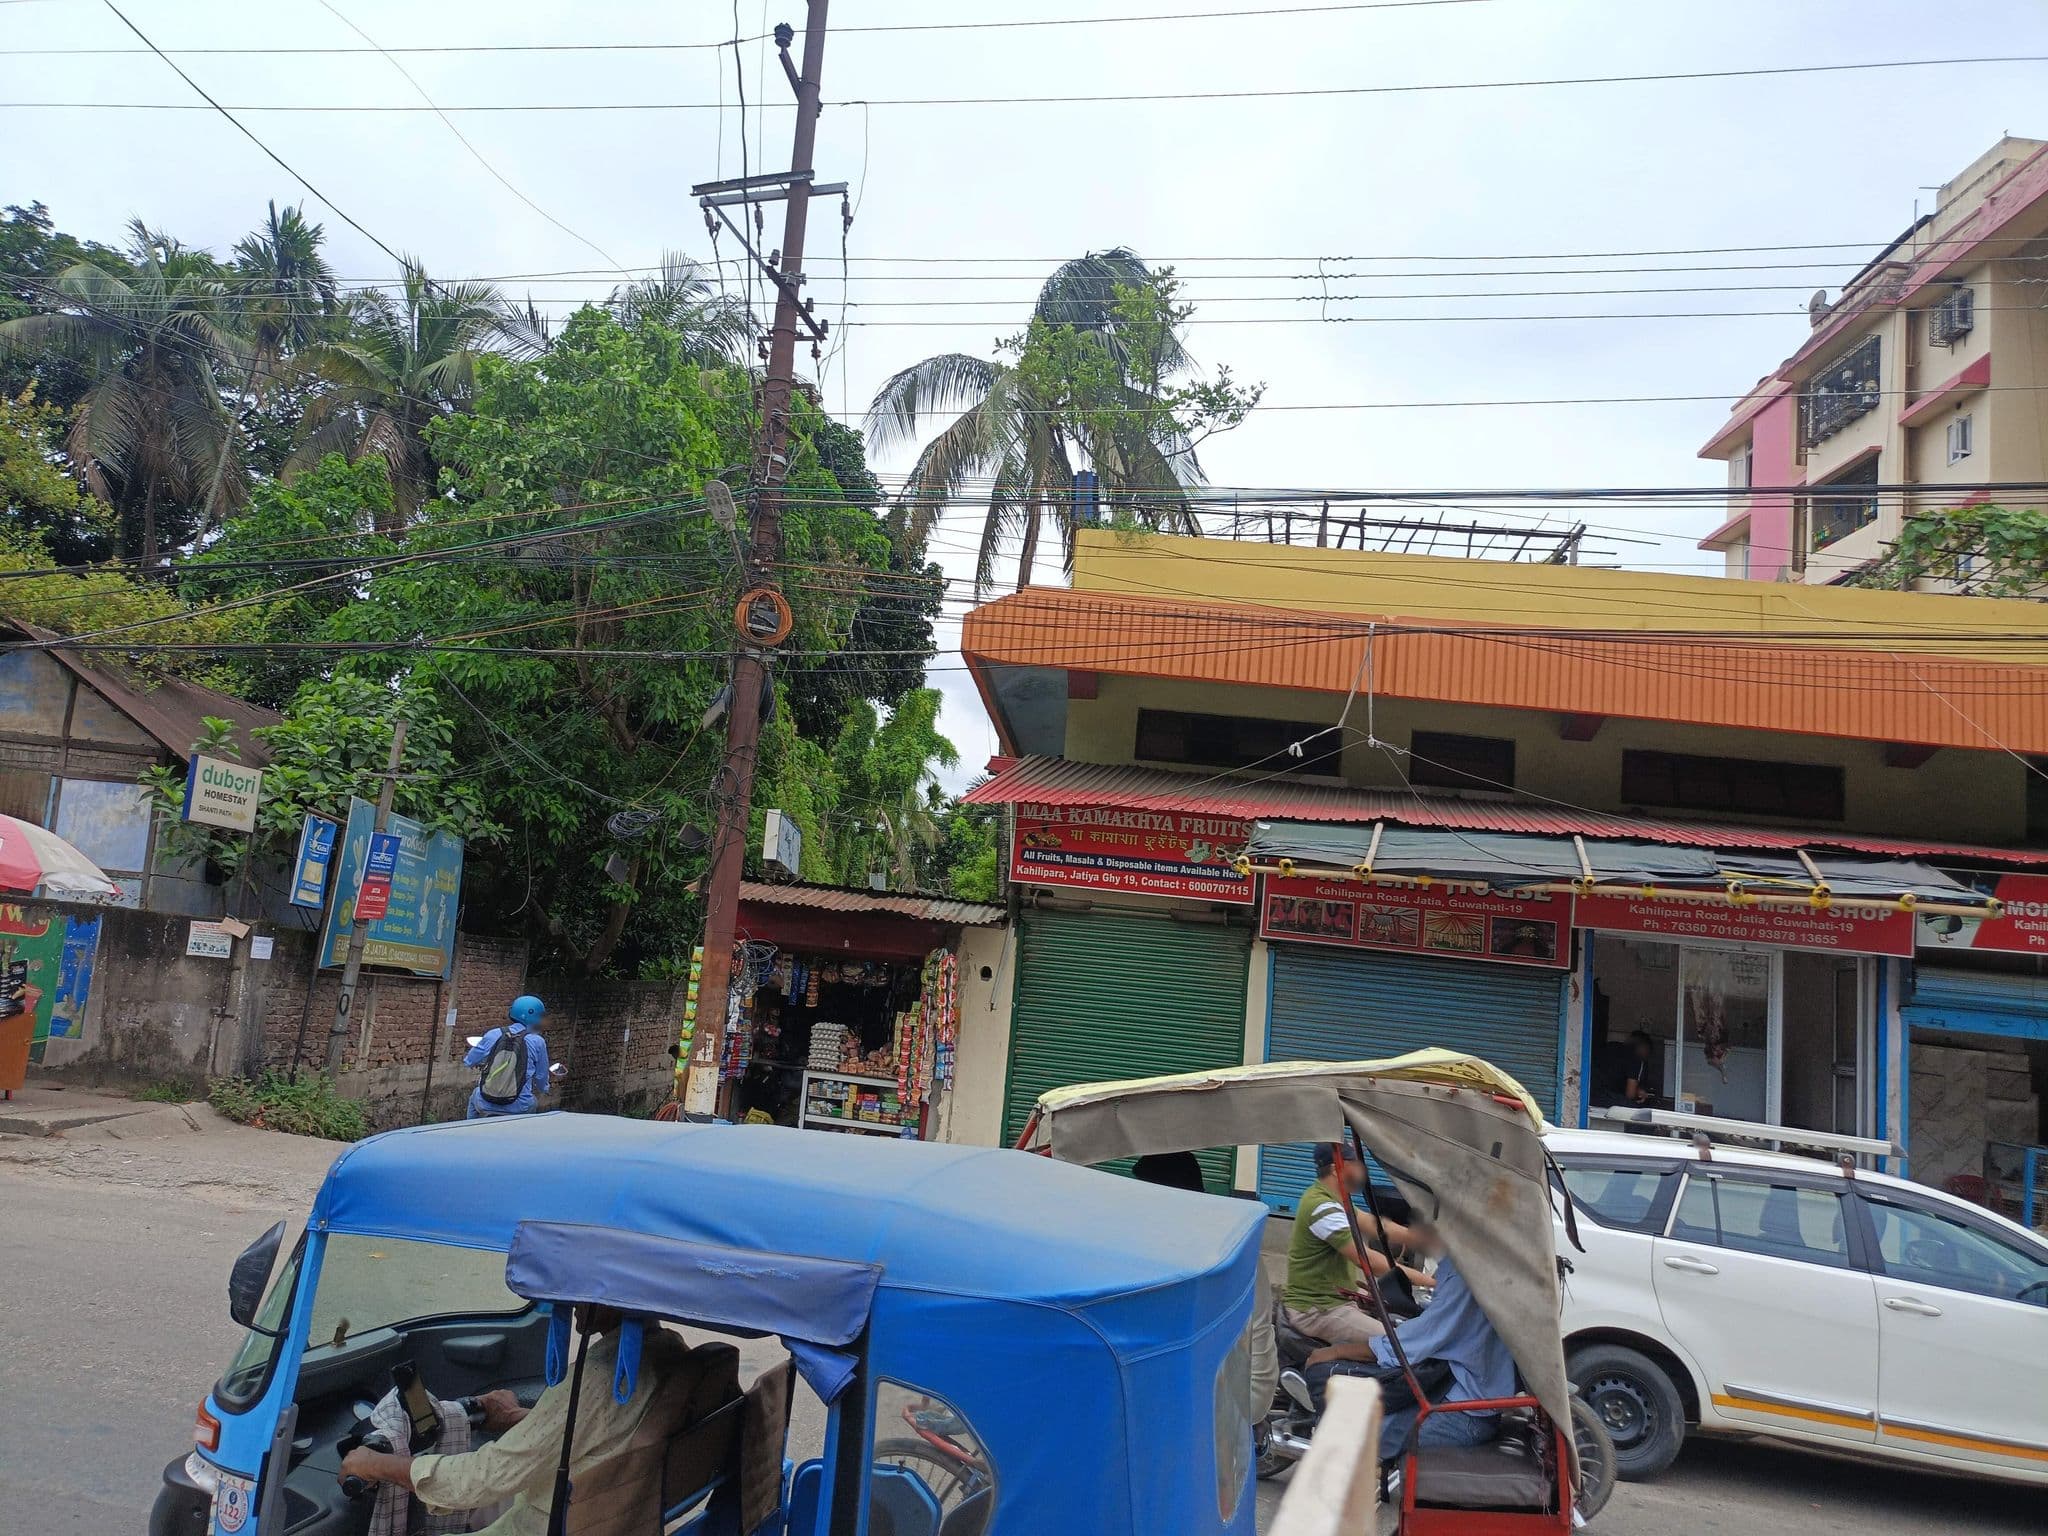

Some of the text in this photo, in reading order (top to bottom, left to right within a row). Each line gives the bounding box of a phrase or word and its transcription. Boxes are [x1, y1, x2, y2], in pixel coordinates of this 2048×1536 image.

[202, 765, 256, 794] dubori
[204, 788, 248, 806] HOMESTAY
[1023, 803, 1252, 838] MAA KAMAKHYA FRUITS
[1023, 850, 1244, 879] All Fruits, Masala & Disposable items Available Here
[1016, 864, 1067, 880] Kahilipara,
[1070, 869, 1099, 883] Jatiya
[1102, 872, 1121, 885] Ghy
[1123, 874, 1138, 888] 19,
[1141, 876, 1180, 890] Contact
[1188, 881, 1249, 896] 6000707115
[1315, 886, 1523, 914] Kahilipara Road, Jatia, Guwahati-19
[1827, 904, 1893, 921] SHOP
[1629, 904, 1854, 933] Kahilipara Road, Jatia, Guwahati-19
[1643, 919, 1659, 930] Ph
[1671, 921, 1708, 933] 76360
[1711, 924, 1748, 937] 70160
[1758, 927, 1797, 942] 93878
[1800, 932, 1839, 945] 13655
[2028, 934, 2046, 945] Ph
[223, 1503, 239, 1520] 122
